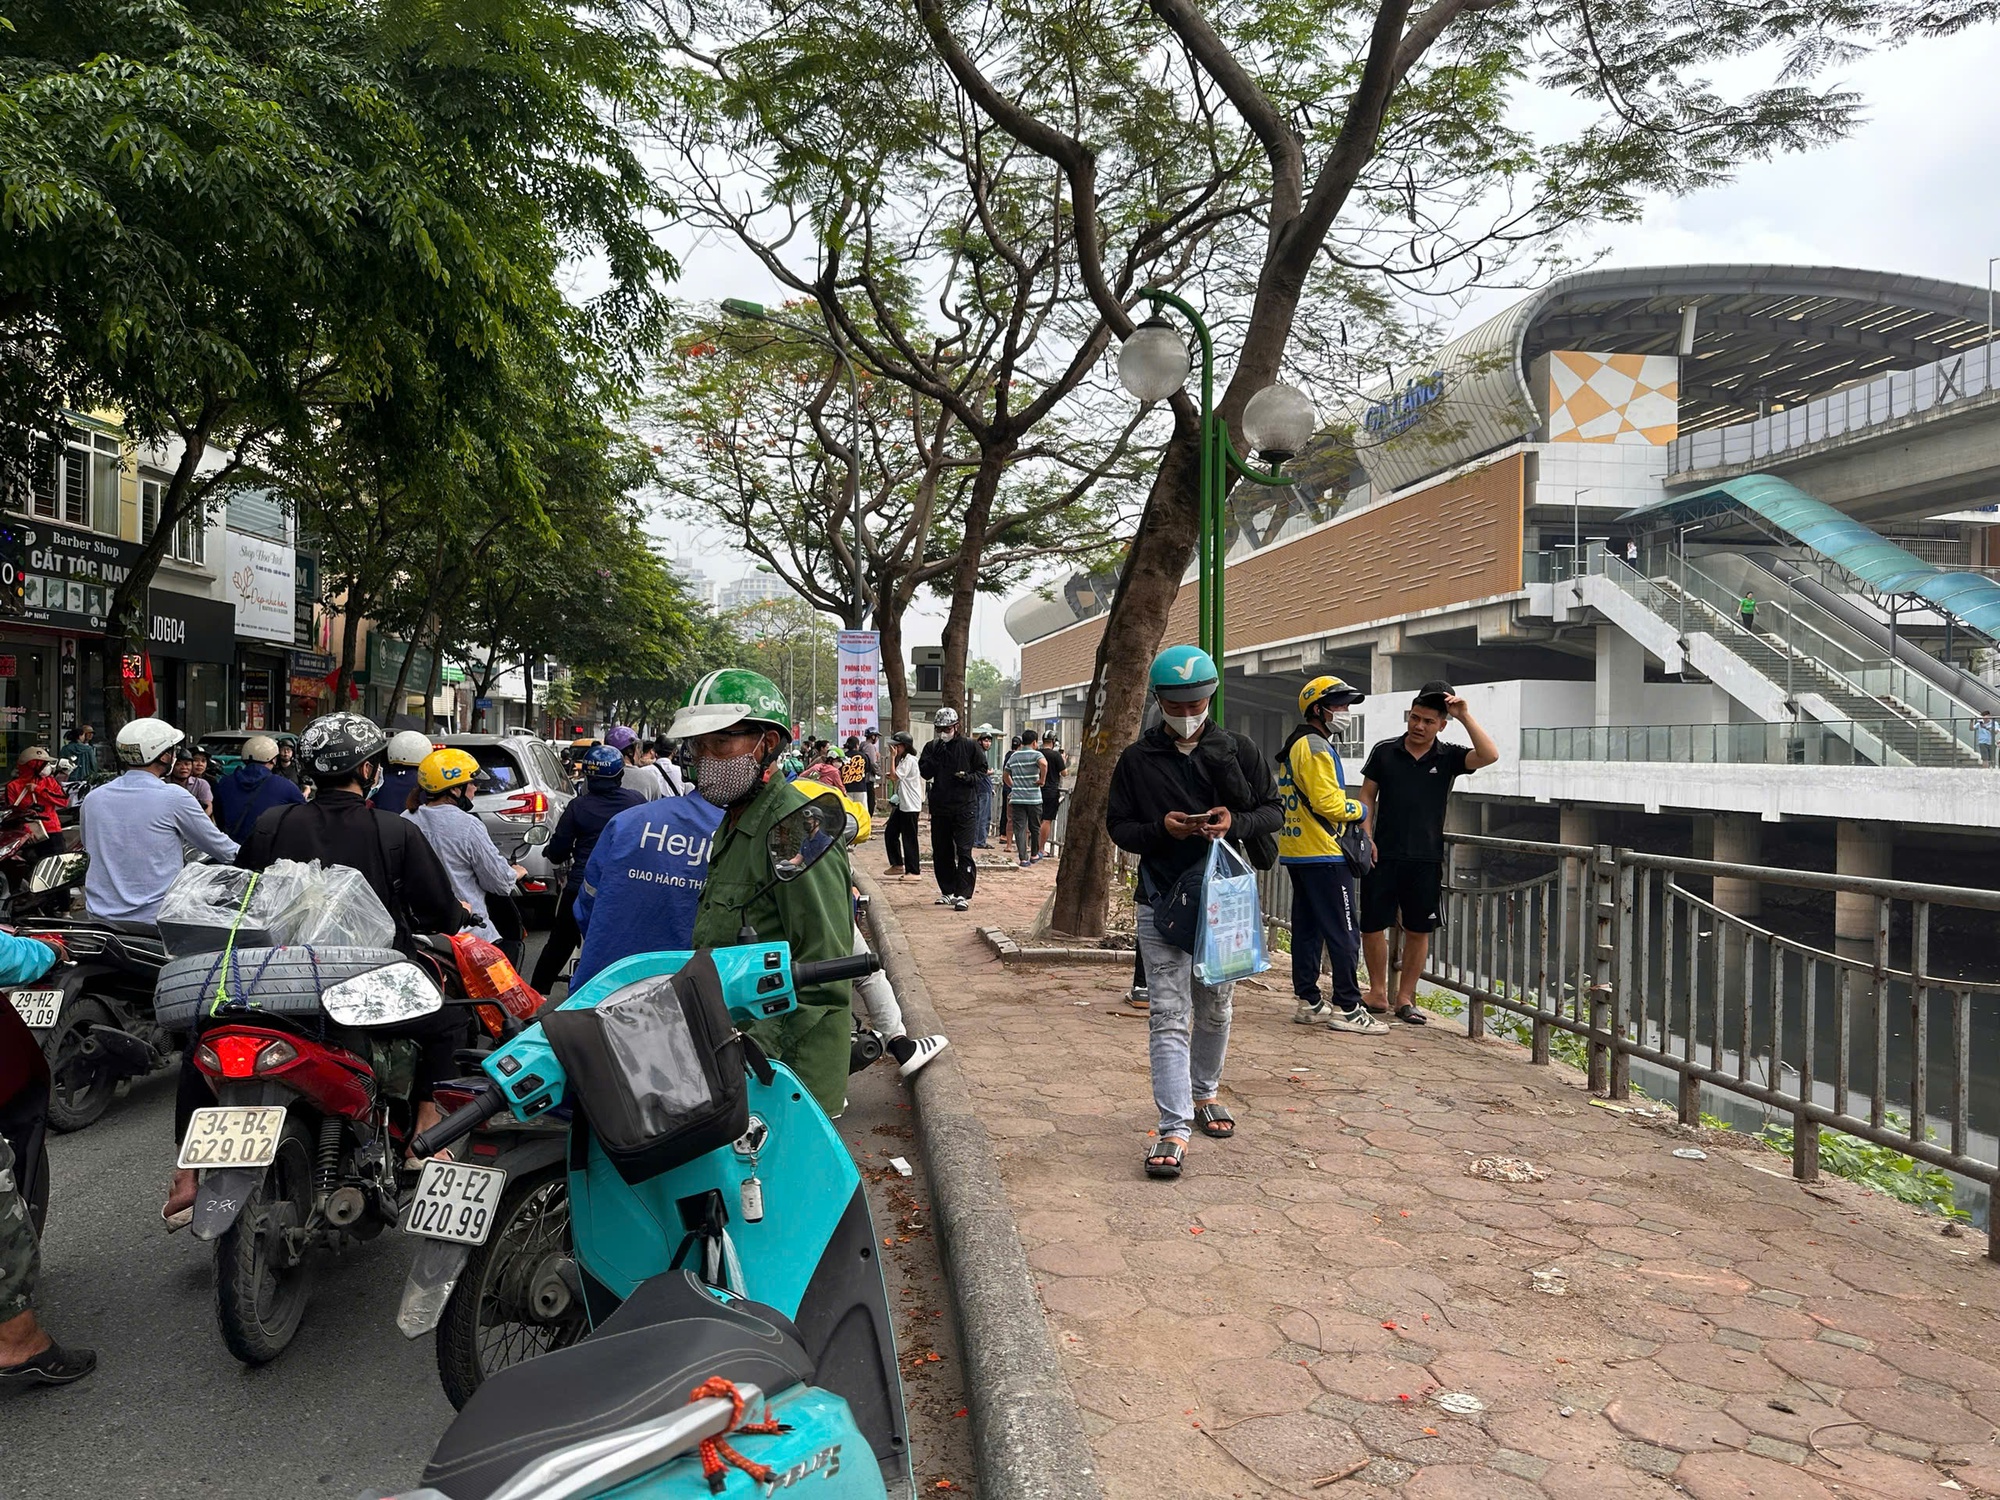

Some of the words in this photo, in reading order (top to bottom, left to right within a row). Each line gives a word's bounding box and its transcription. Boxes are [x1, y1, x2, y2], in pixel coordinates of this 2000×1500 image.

[53, 531, 91, 550] Barber
[94, 542, 119, 558] Shop
[31, 546, 63, 572] CẮT
[68, 555, 98, 578] TÓC
[1302, 687, 1316, 700] be
[851, 754, 866, 767] Be
[441, 768, 461, 780] be
[628, 868, 653, 881] GIAO
[16, 993, 54, 1007] 29-H2
[203, 1111, 268, 1135] 34-B4
[187, 1137, 272, 1162] 629.02
[427, 1166, 491, 1204] 29-E2
[411, 1199, 487, 1239] 020.99
